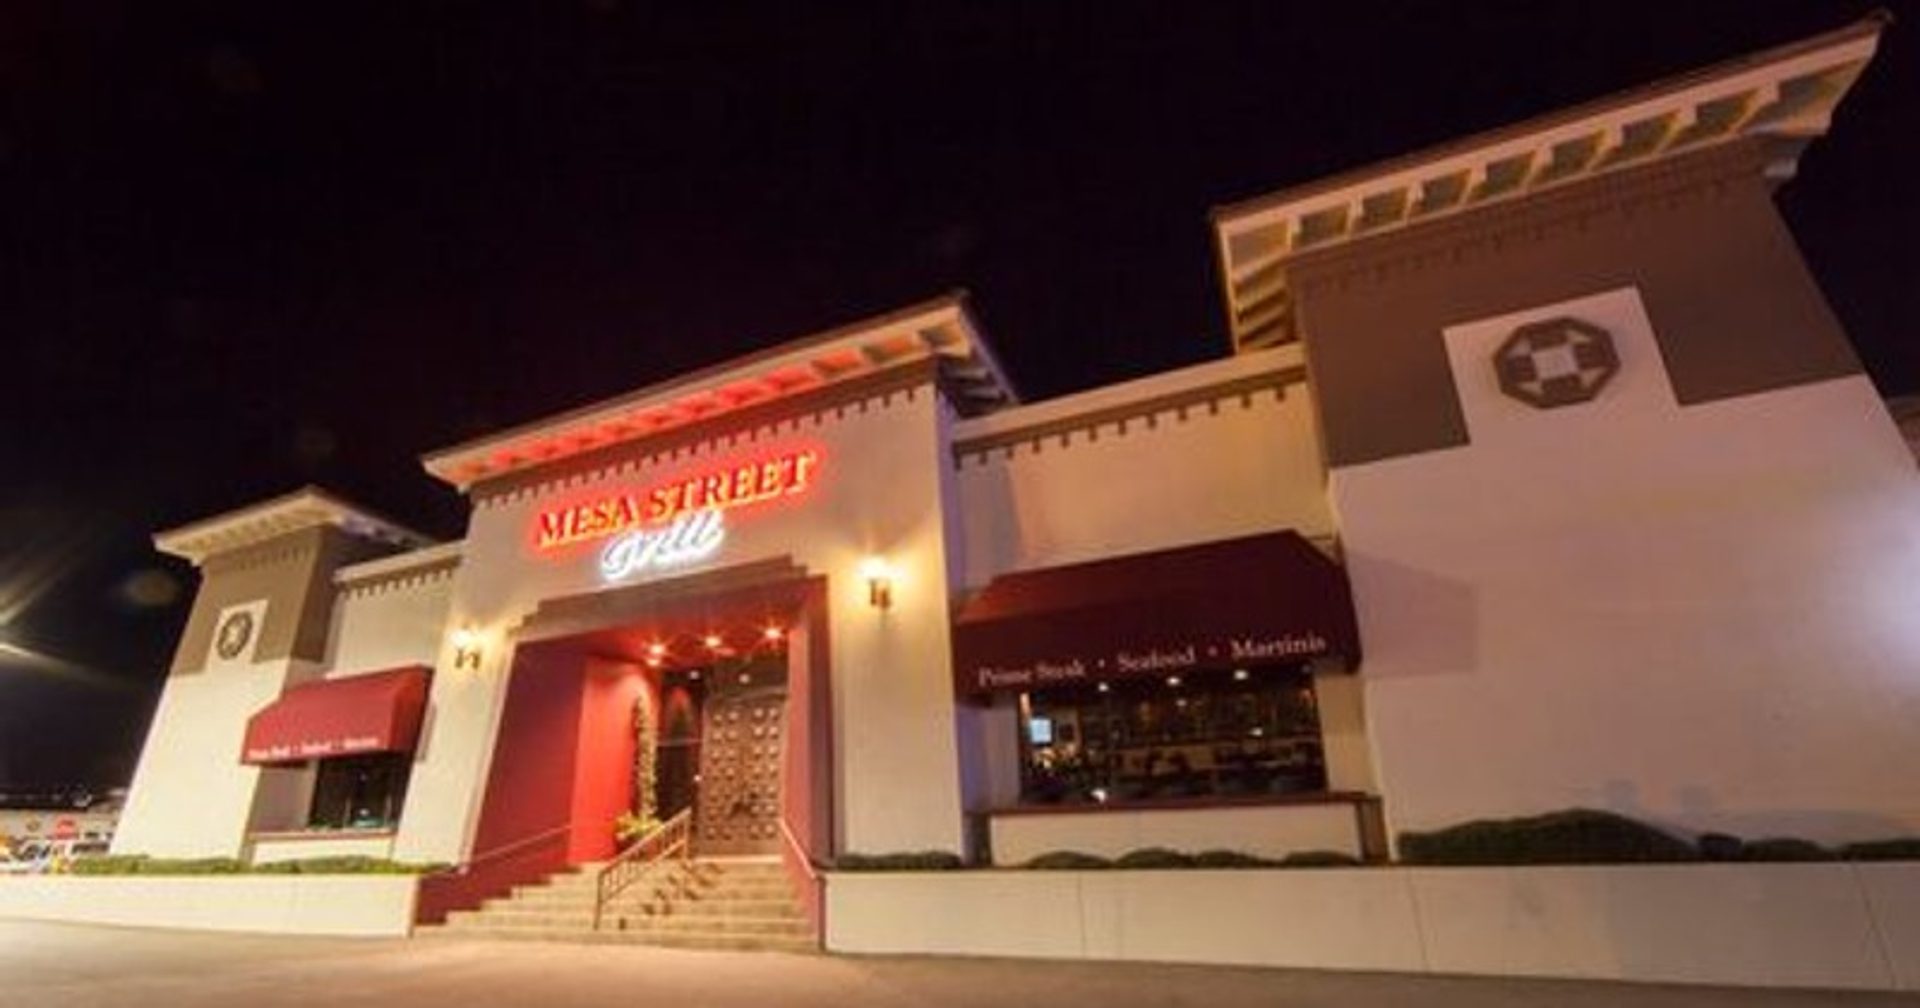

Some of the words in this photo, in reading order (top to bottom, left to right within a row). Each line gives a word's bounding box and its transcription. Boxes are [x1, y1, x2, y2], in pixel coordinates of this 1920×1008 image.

[537, 495, 640, 546] MESA
[649, 452, 817, 522] STREET
[601, 509, 724, 578] Grill
[1117, 646, 1195, 673] Seafood
[1230, 632, 1327, 661] Martinis
